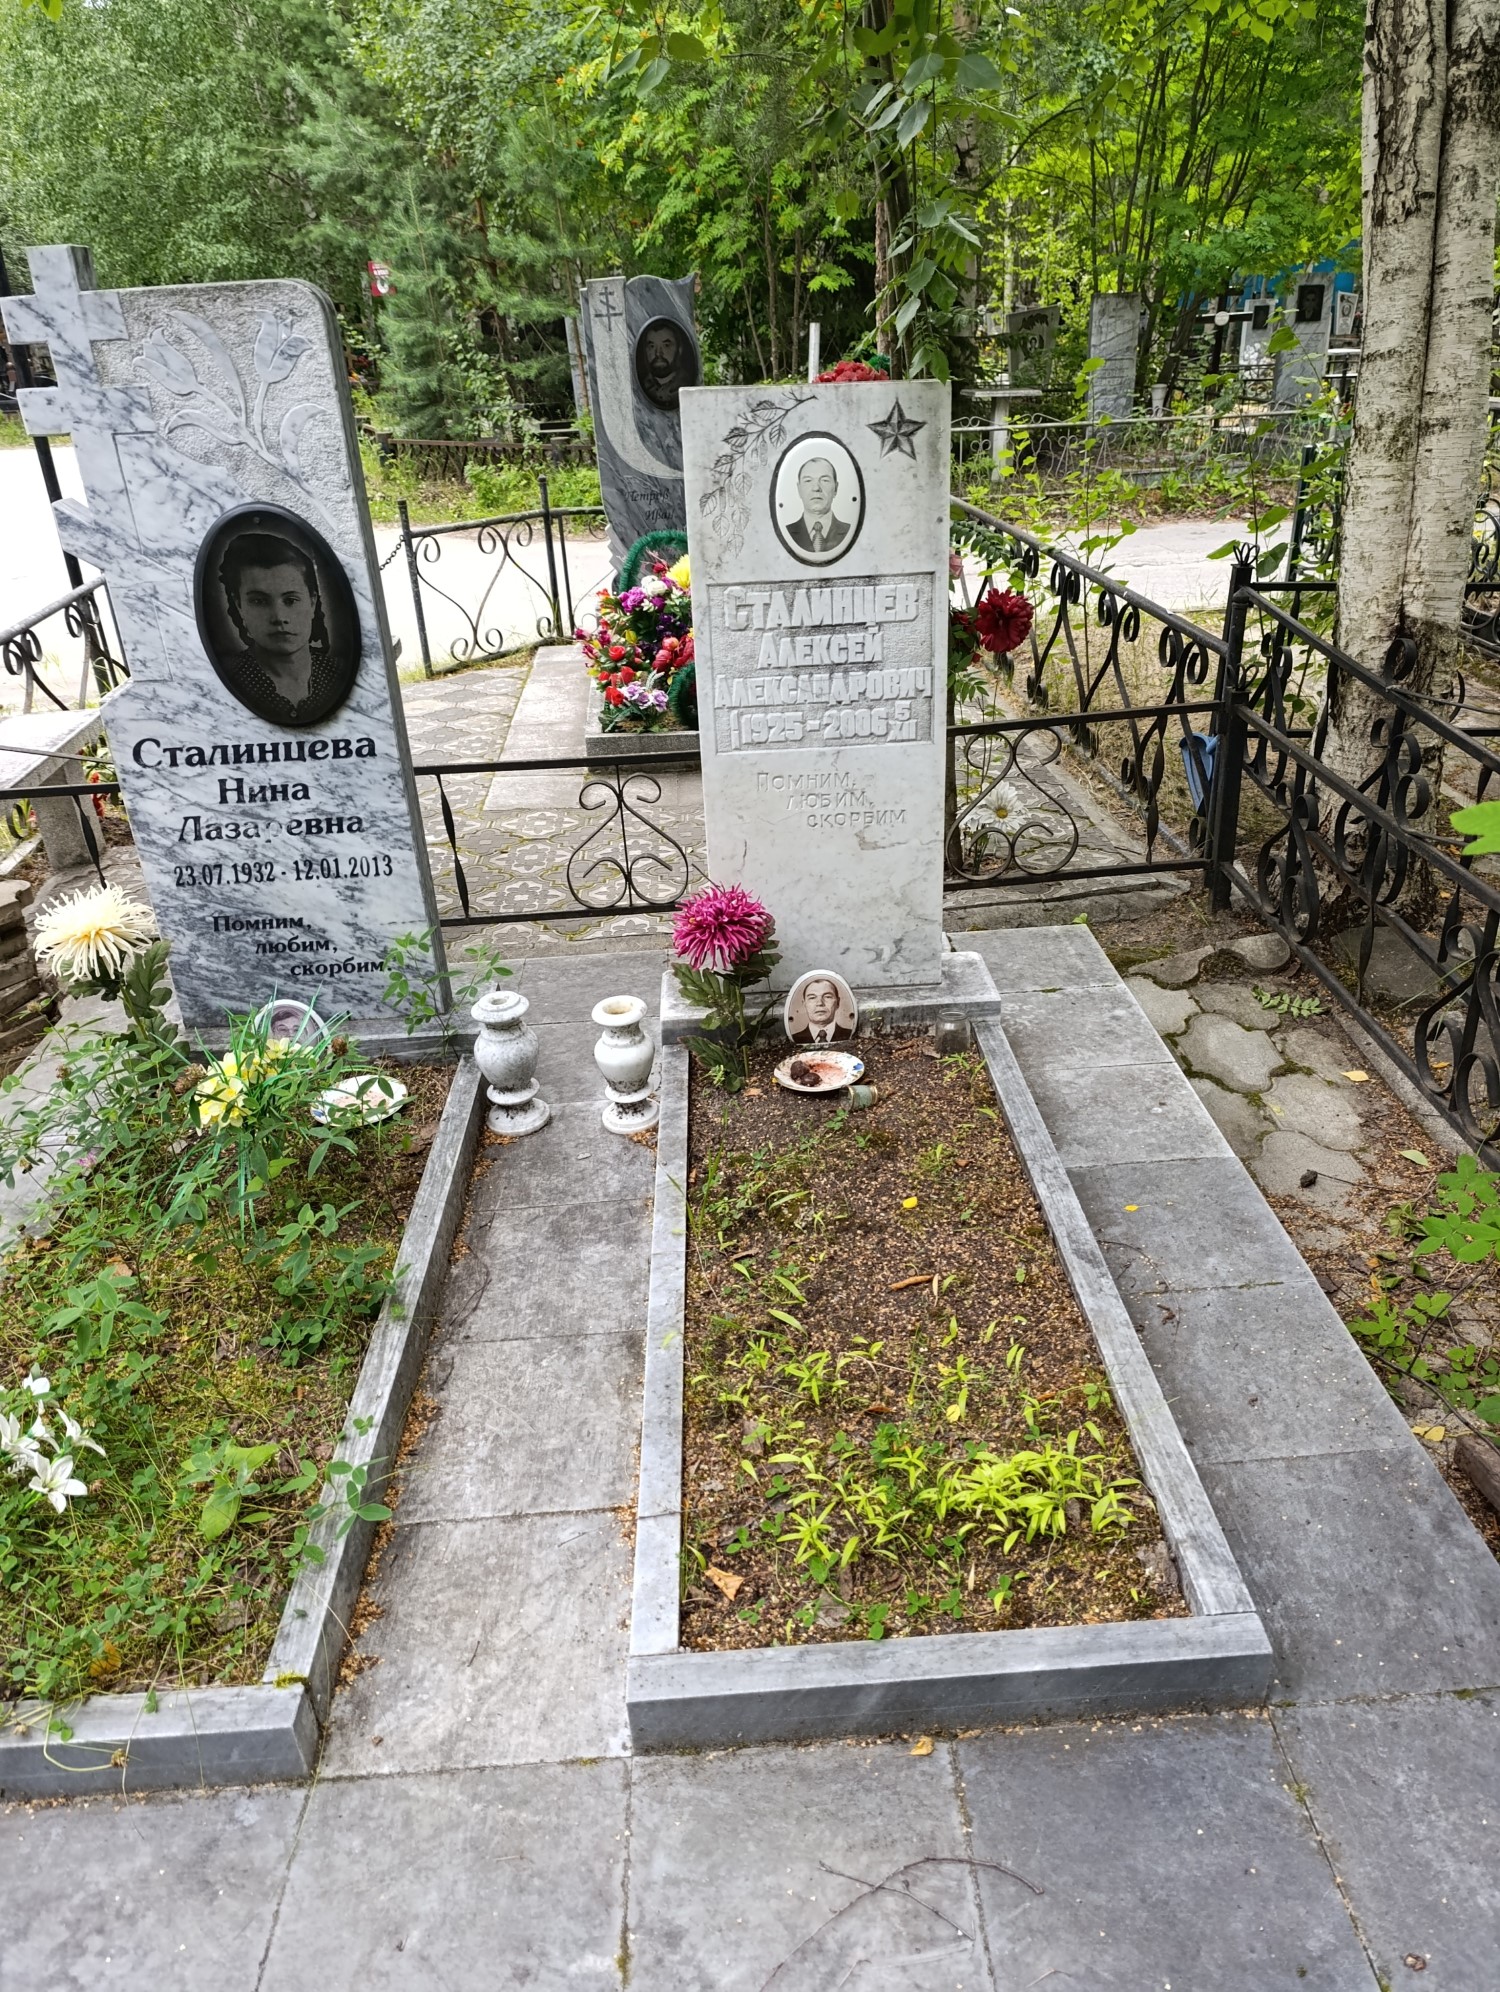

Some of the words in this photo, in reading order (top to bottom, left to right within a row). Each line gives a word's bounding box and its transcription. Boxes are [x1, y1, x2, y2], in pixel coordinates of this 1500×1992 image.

[723, 584, 919, 631] СТАЛИНЦЕВ
[757, 626, 883, 669] АЛЕКСЕЙ
[714, 667, 933, 709] АЛЕКСАНДРОВИЧ
[132, 736, 378, 768] Сталинцева
[218, 778, 310, 804] Нина
[756, 772, 856, 793] ПОМНИМ,
[178, 815, 365, 843] Лазаревна
[806, 809, 906, 828] СКОРБИМ
[174, 861, 275, 887] 23.07.1932
[294, 855, 393, 881] 12.01.2013
[212, 915, 311, 932] Помним,
[255, 936, 337, 955] любим,
[290, 957, 392, 977] скорбим.
